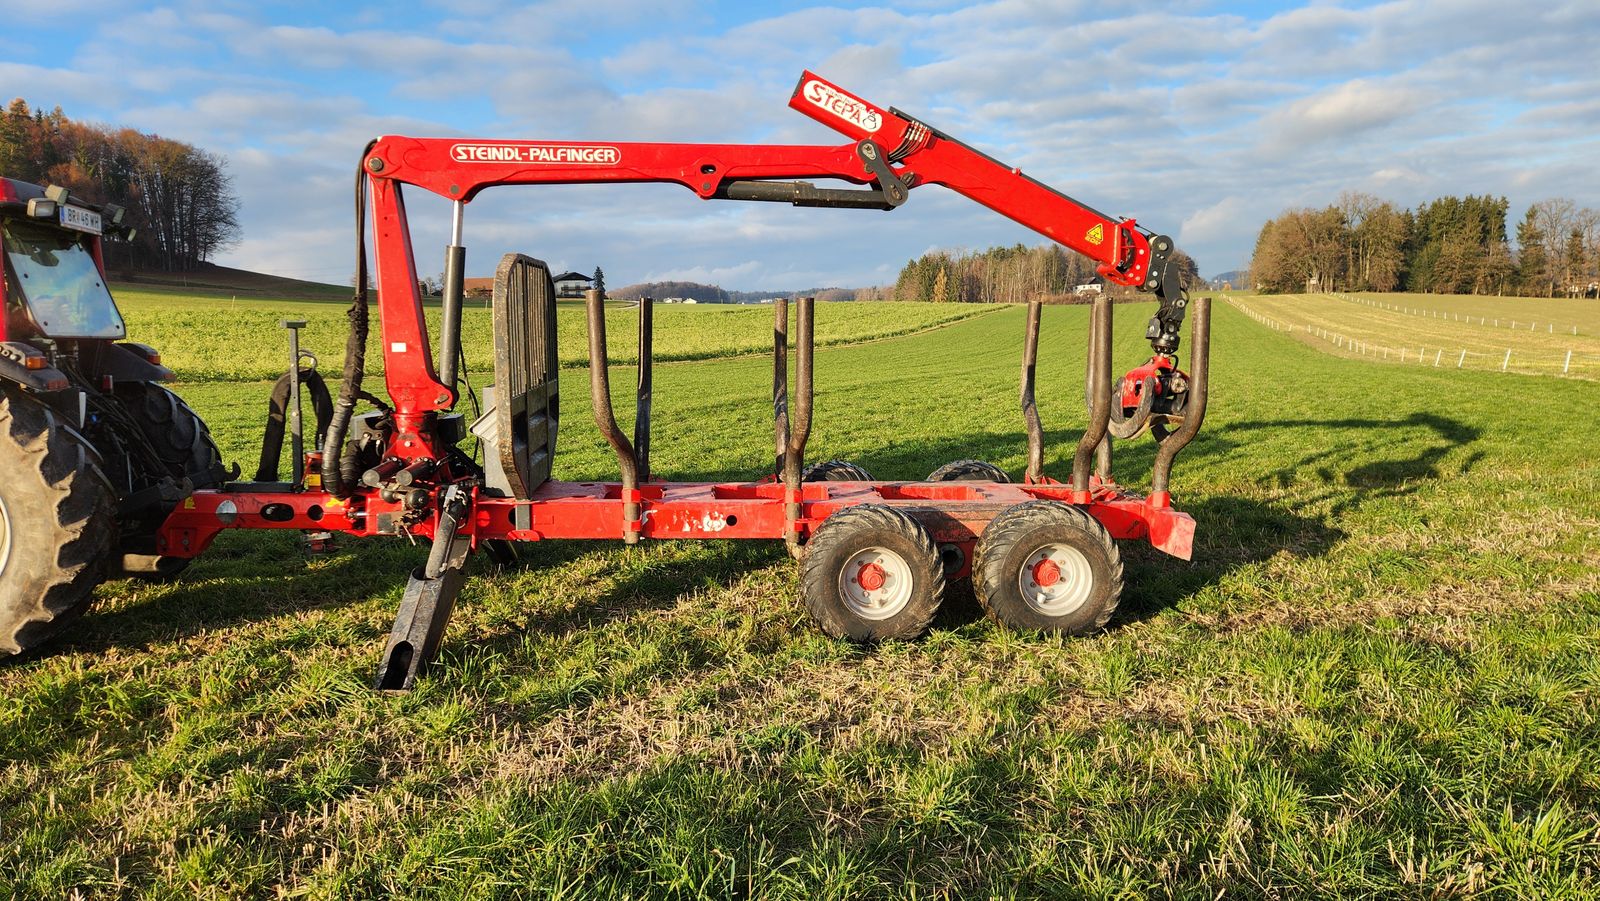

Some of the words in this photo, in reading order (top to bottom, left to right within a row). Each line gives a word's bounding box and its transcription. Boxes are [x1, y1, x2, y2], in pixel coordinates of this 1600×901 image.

[809, 84, 861, 123] STEPA
[456, 147, 615, 162] STEINDL-PALFINGER
[68, 208, 77, 223] BR
